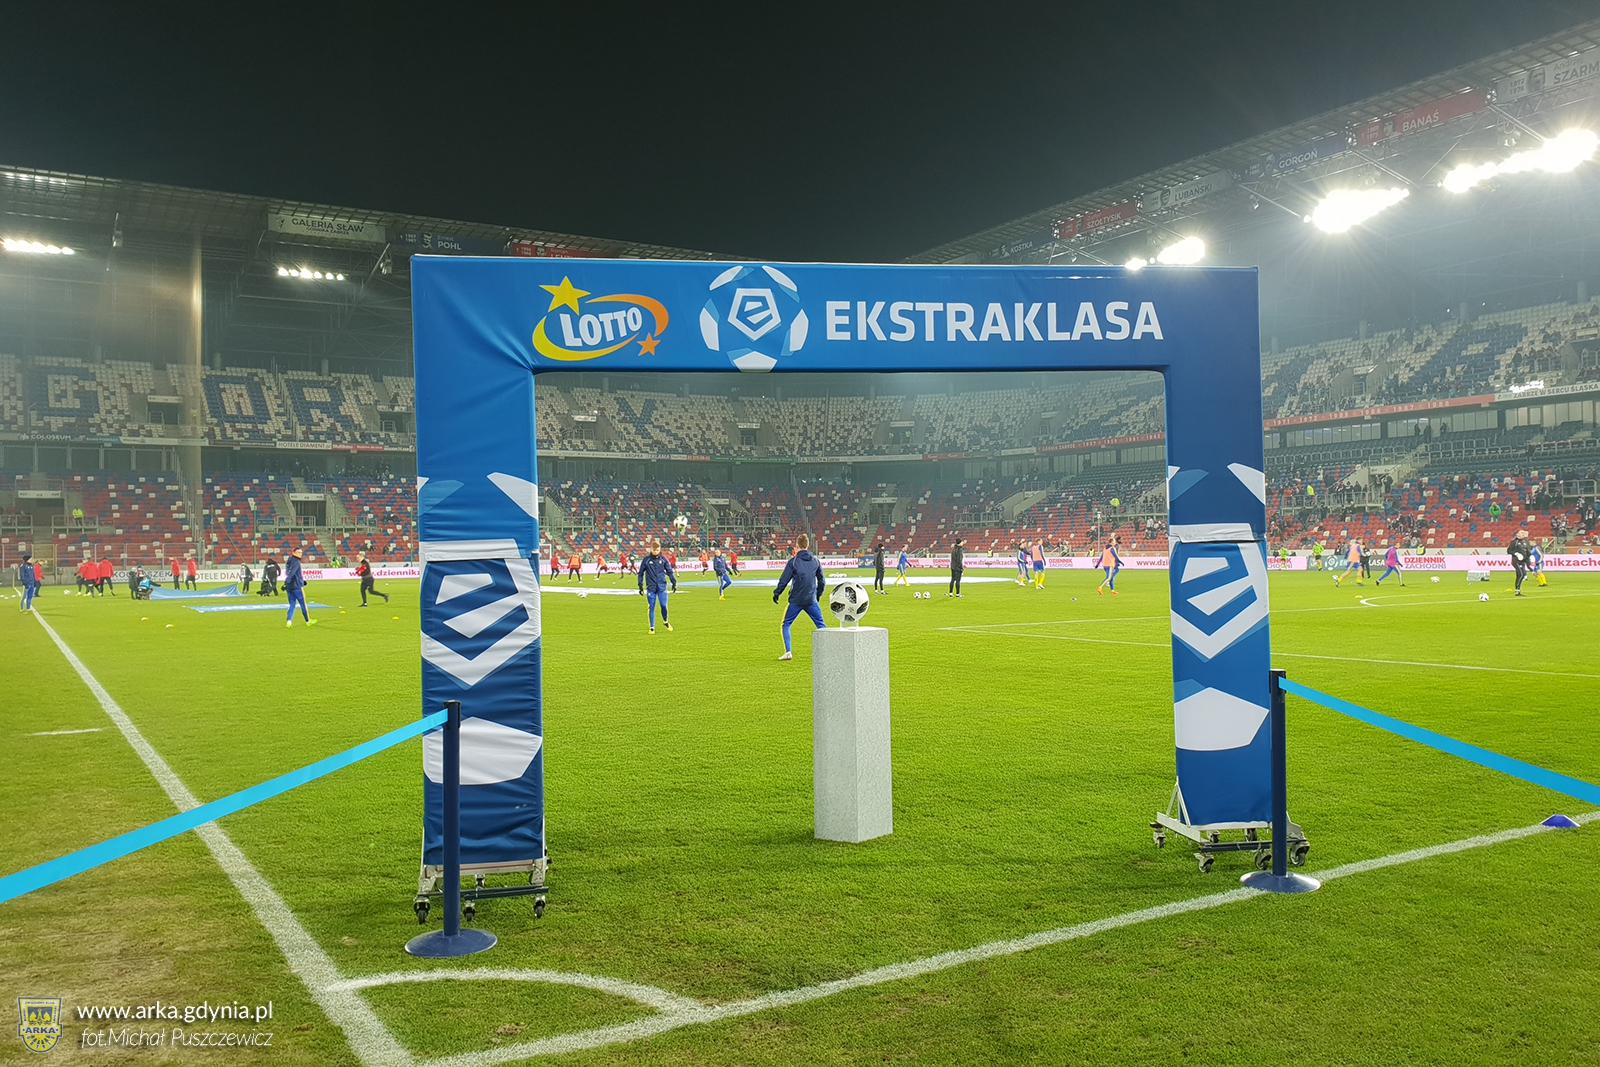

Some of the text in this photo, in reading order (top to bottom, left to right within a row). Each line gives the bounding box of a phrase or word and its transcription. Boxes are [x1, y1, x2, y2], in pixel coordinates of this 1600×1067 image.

[1402, 109, 1439, 132] BANAŚ
[1278, 148, 1318, 168] GORGOŃ
[1174, 183, 1212, 201] LUBAŃSKI
[291, 218, 364, 232] GALERIA SŁAW
[437, 241, 461, 250] POHL
[559, 307, 643, 347] LOTTO
[826, 300, 1164, 342] EKSTRAKLASA
[1513, 390, 1538, 399] ZABRZE
[1547, 387, 1569, 395] SERCU
[1571, 384, 1599, 393] ŚLĄSKA
[1393, 404, 1414, 412] 1987
[196, 572, 219, 580] OTELE
